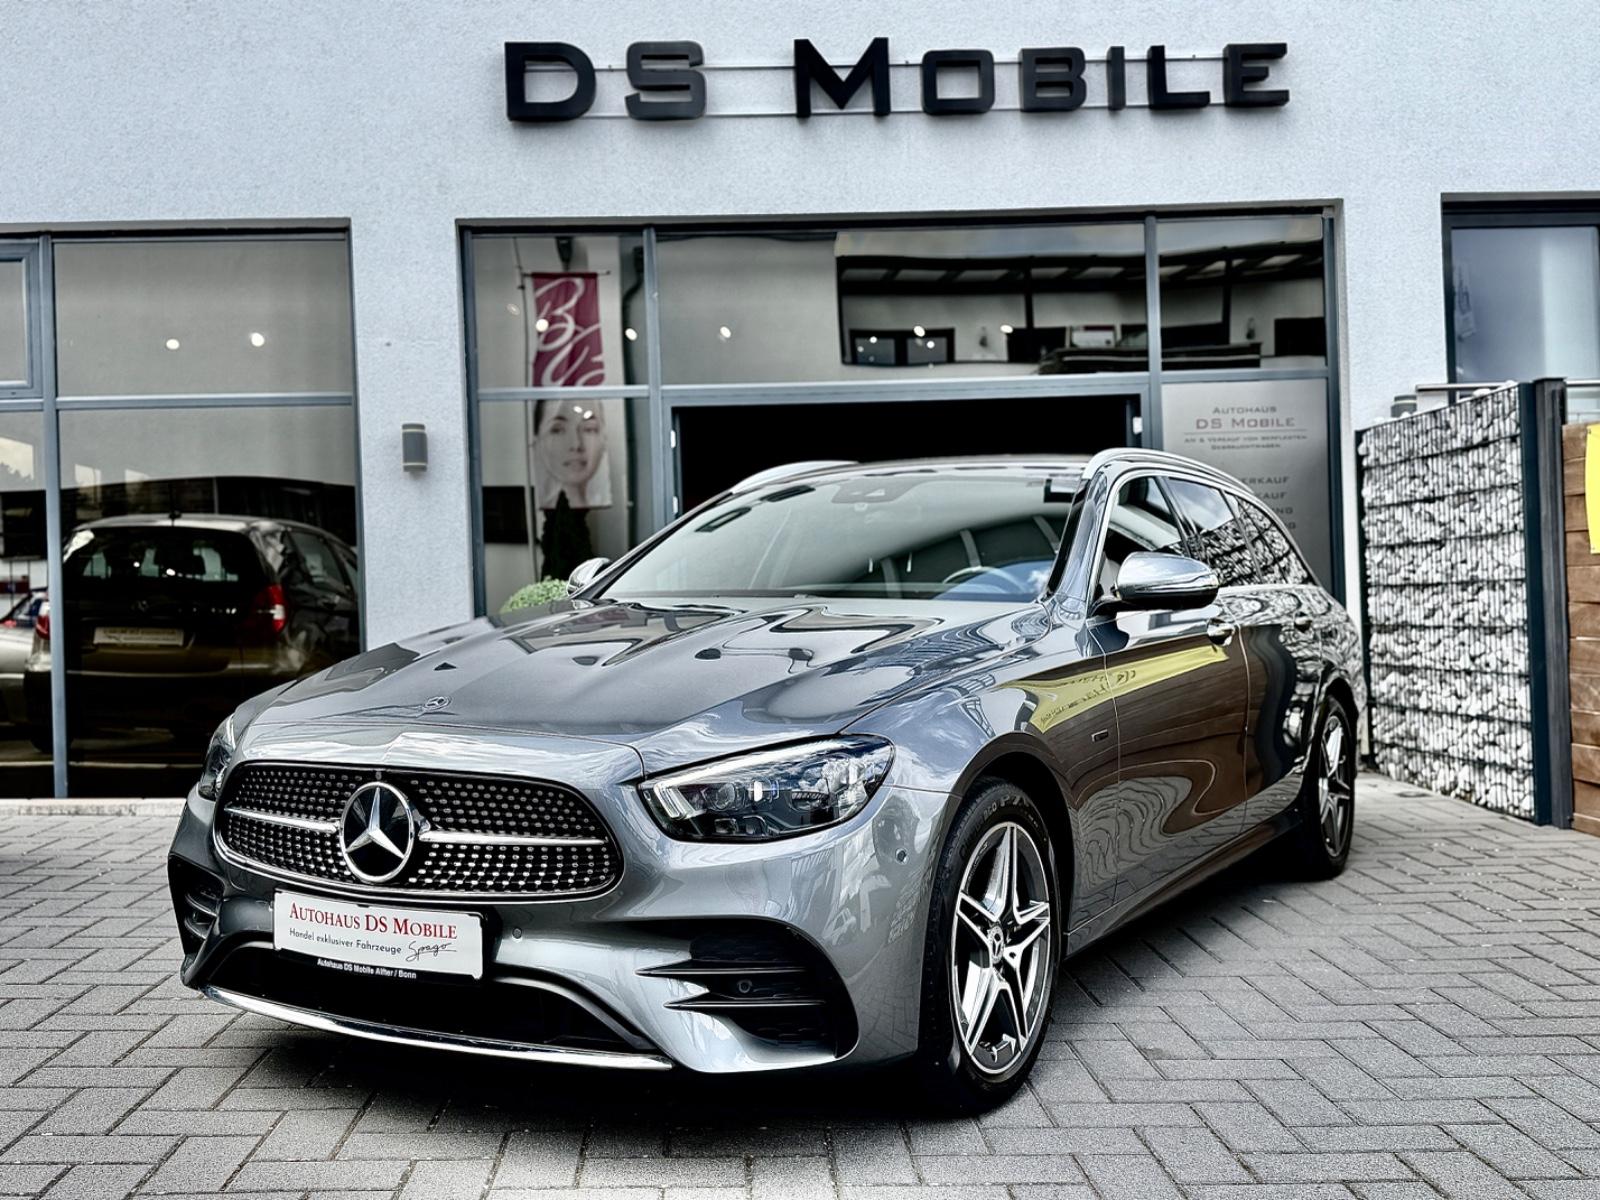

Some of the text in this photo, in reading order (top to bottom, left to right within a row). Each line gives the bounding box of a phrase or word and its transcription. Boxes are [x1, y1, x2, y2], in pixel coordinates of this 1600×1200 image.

[504, 37, 1290, 122] DS MOBILE
[1212, 406, 1277, 415] AUTOHAUS
[1196, 417, 1296, 429] DS MOBILE
[1241, 476, 1290, 484] ERKAUF
[290, 902, 458, 939] AUTOHAUS DS MOBILE
[289, 927, 315, 941] Handel
[316, 933, 354, 948] exklusiver
[355, 939, 401, 954] Fahrzeuge
[317, 958, 343, 970] Autohaus
[344, 963, 353, 972] DS
[353, 964, 374, 974] Mobile
[398, 970, 417, 979] Bonn
